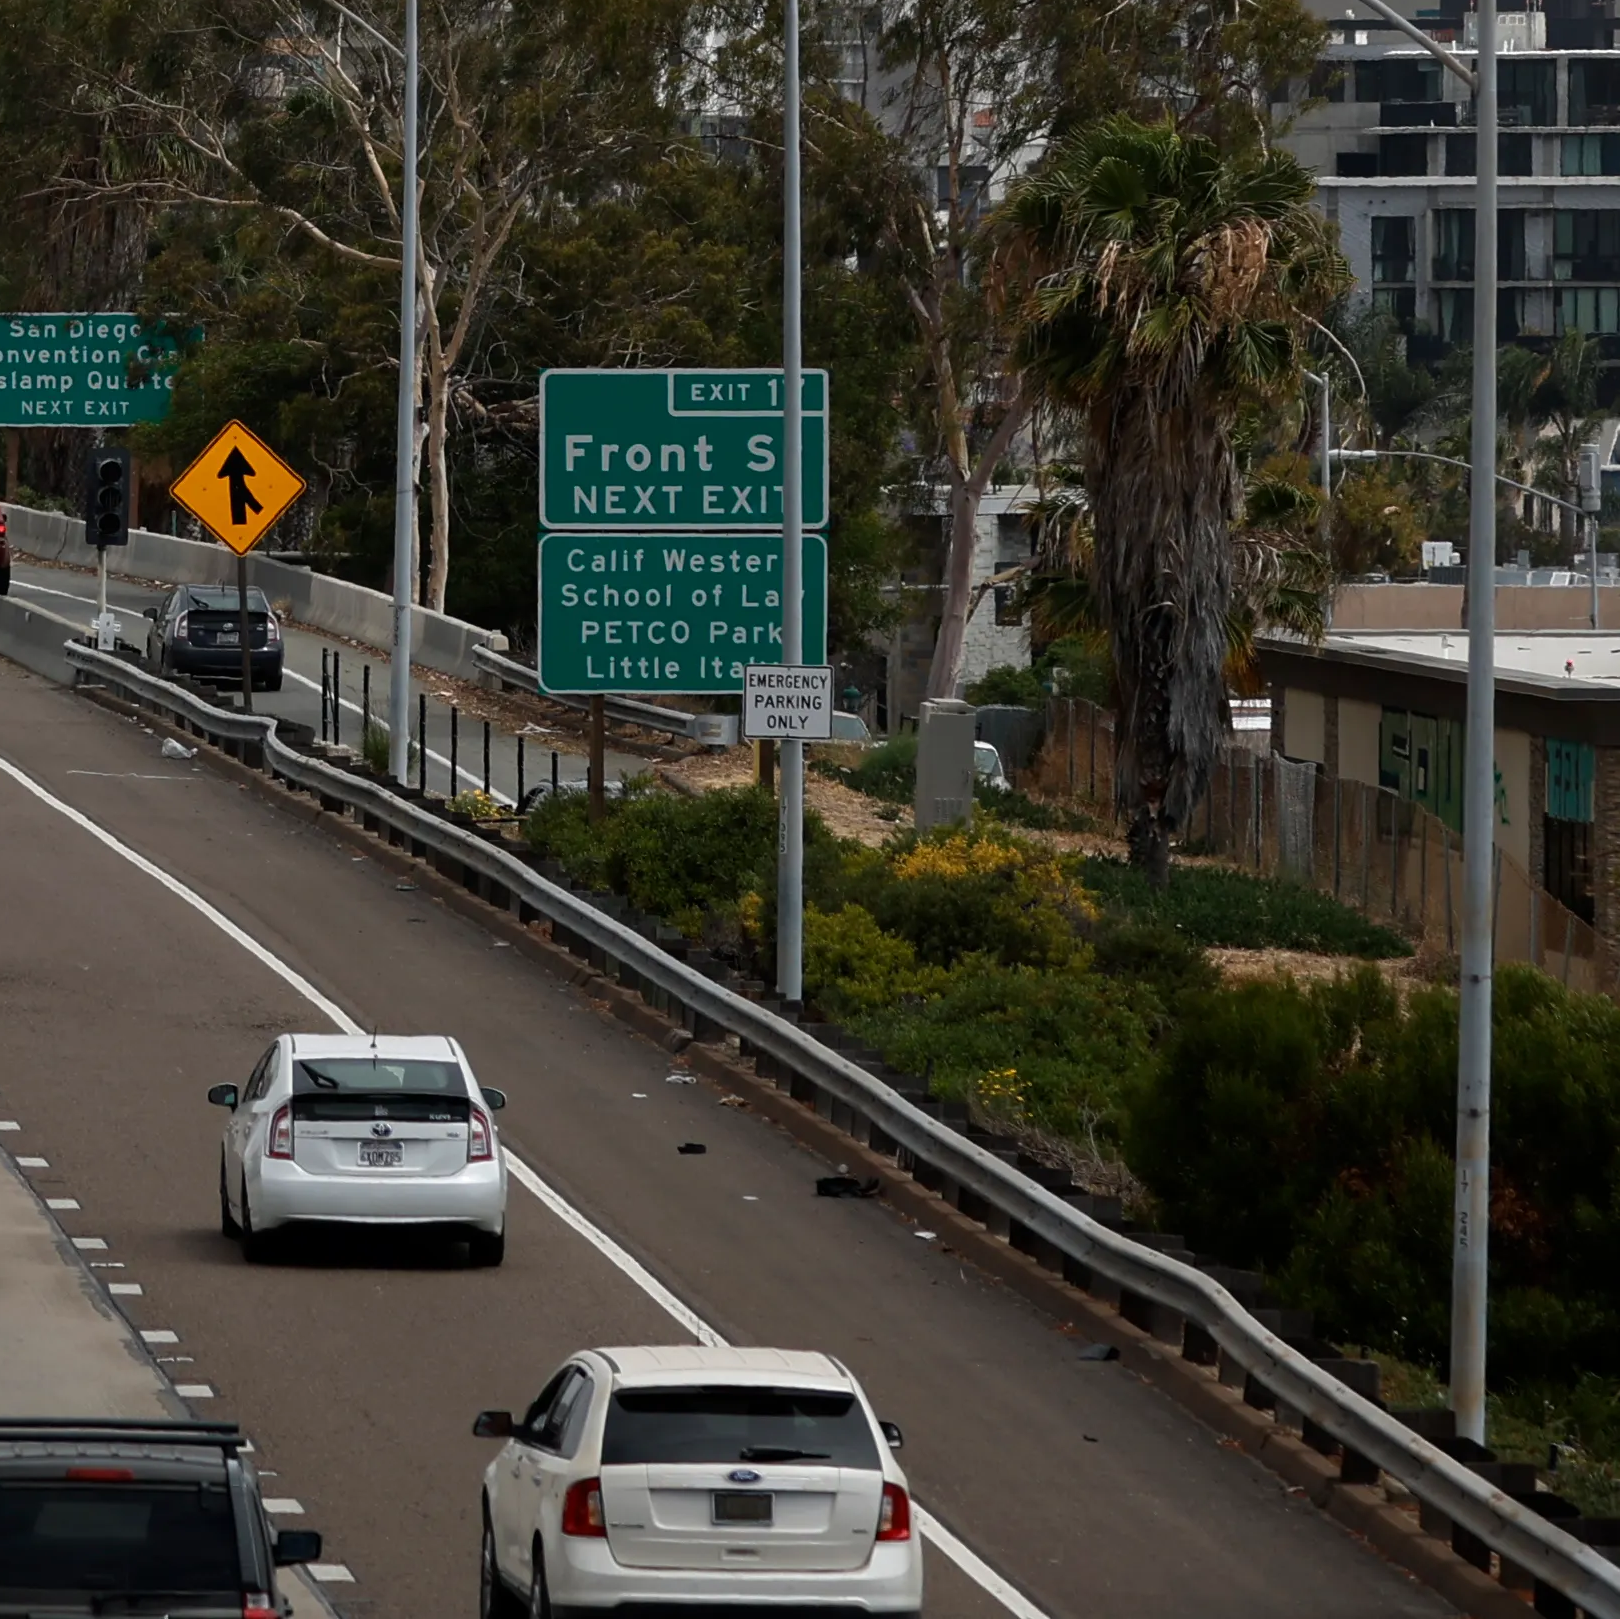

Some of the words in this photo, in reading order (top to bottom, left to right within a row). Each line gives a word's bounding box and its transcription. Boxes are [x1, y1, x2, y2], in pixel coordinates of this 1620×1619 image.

[10, 320, 56, 338] San
[69, 320, 141, 344] Diego
[691, 383, 751, 401] EXIT
[21, 401, 73, 415] NEXT
[85, 401, 130, 415] EXIT
[565, 435, 713, 472] Front
[747, 434, 776, 472] S
[574, 485, 683, 514] NEXT
[567, 548, 644, 572] Calif
[663, 548, 778, 572] Wester
[561, 584, 672, 607] School
[691, 584, 723, 607] of
[581, 621, 690, 645] PETCO
[709, 621, 783, 645] Park
[586, 656, 680, 679] Little
[749, 673, 829, 690] EMERGENCY
[754, 694, 823, 711] PARKING
[767, 714, 809, 730] ONLY
